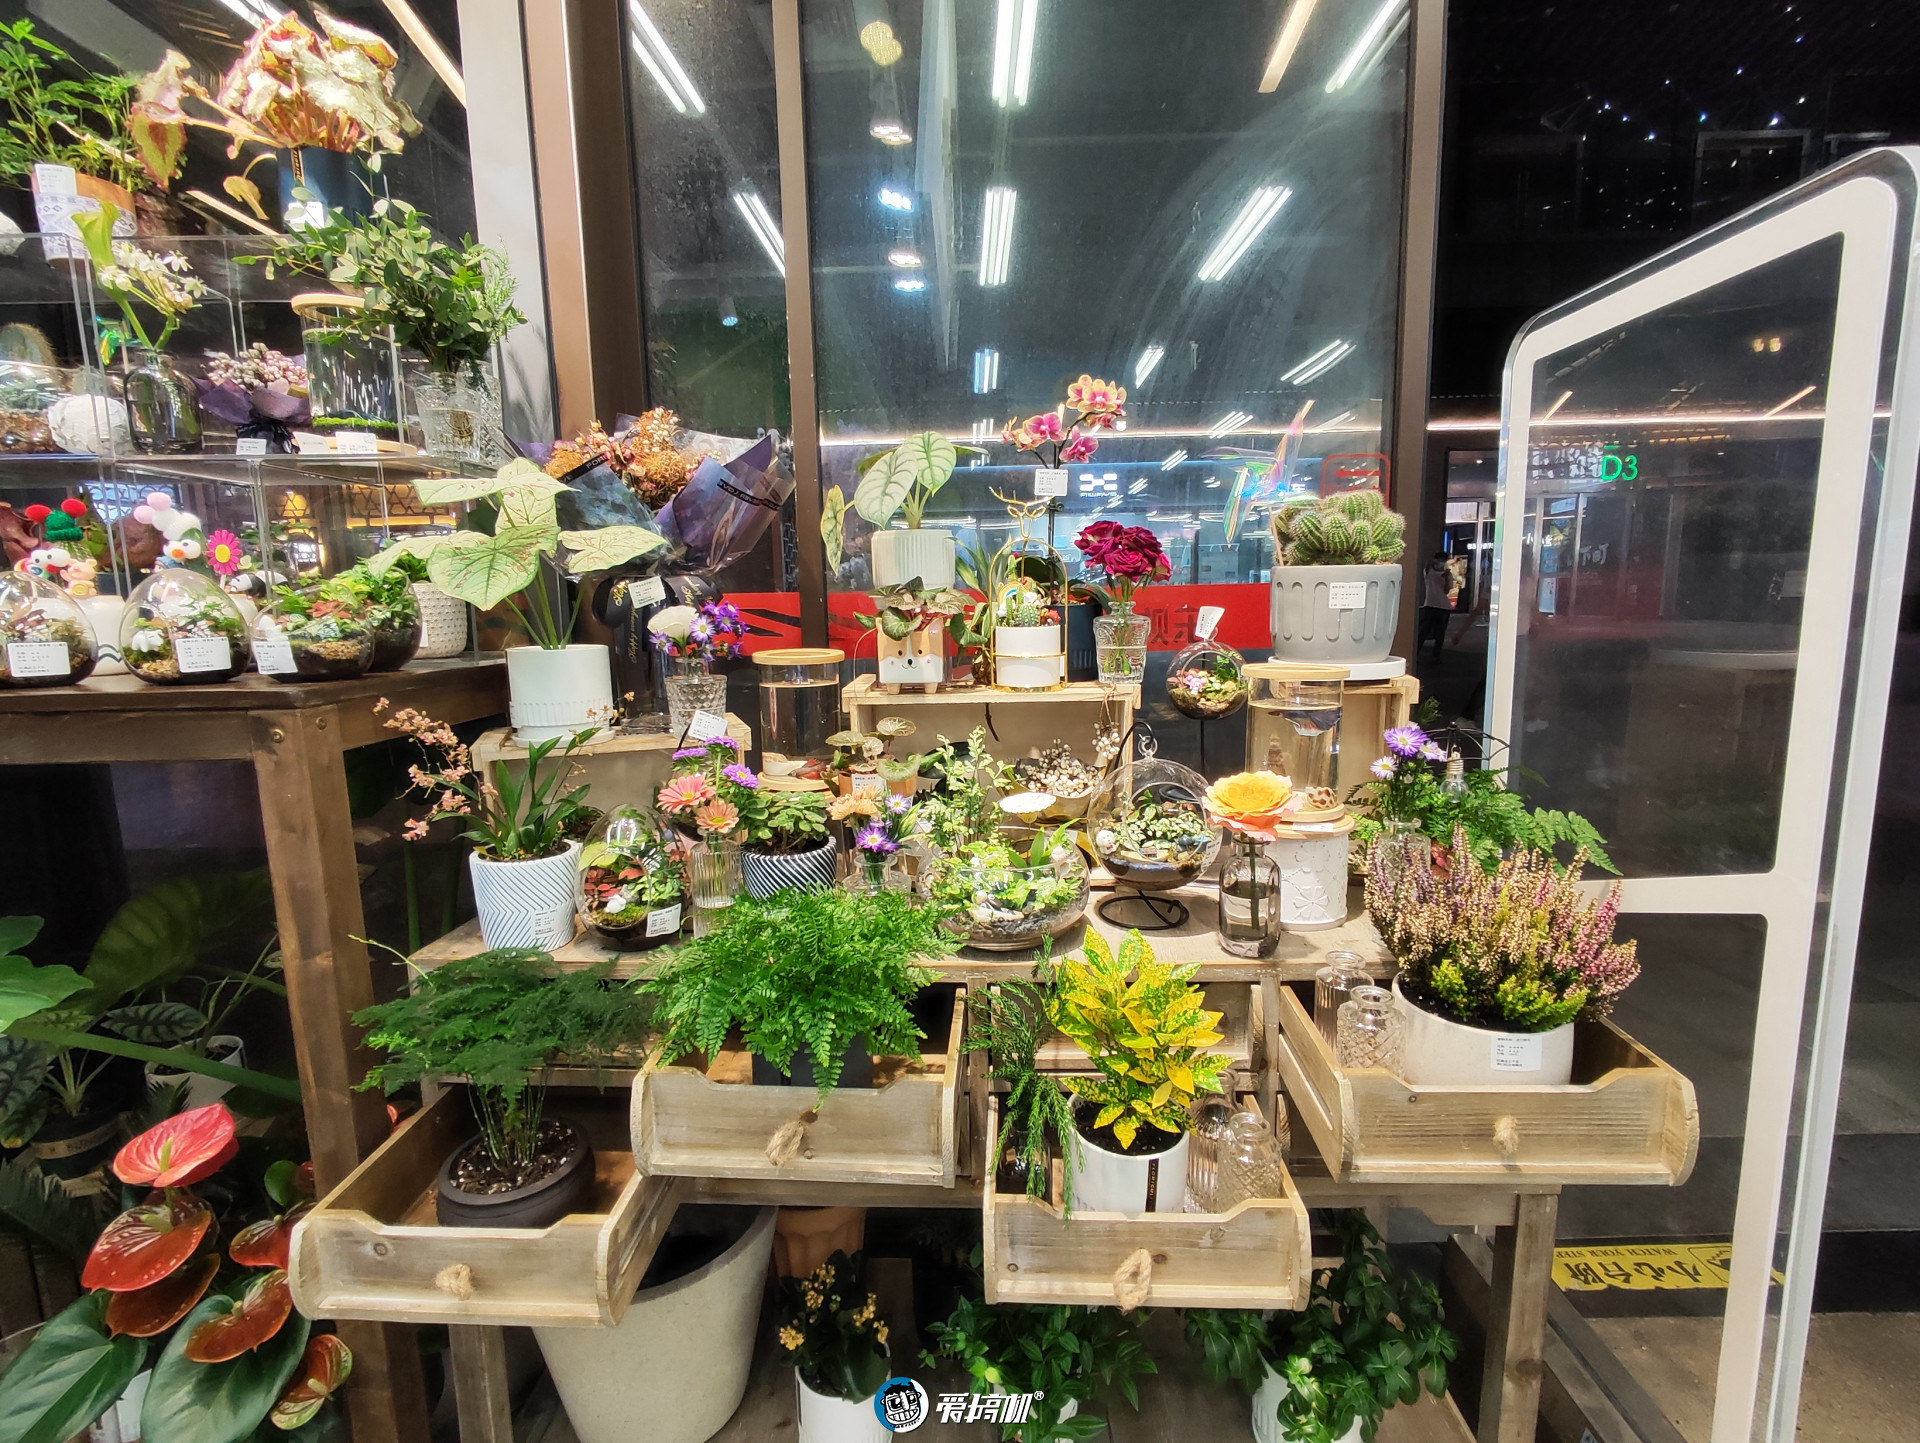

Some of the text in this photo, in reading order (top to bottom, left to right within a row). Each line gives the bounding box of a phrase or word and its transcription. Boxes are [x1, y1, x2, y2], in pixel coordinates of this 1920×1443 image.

[1601, 454, 1639, 482] D3
[1556, 1247, 1678, 1259] WATCH YOUR STEP
[1563, 1260, 1703, 1285] 小心台阶
